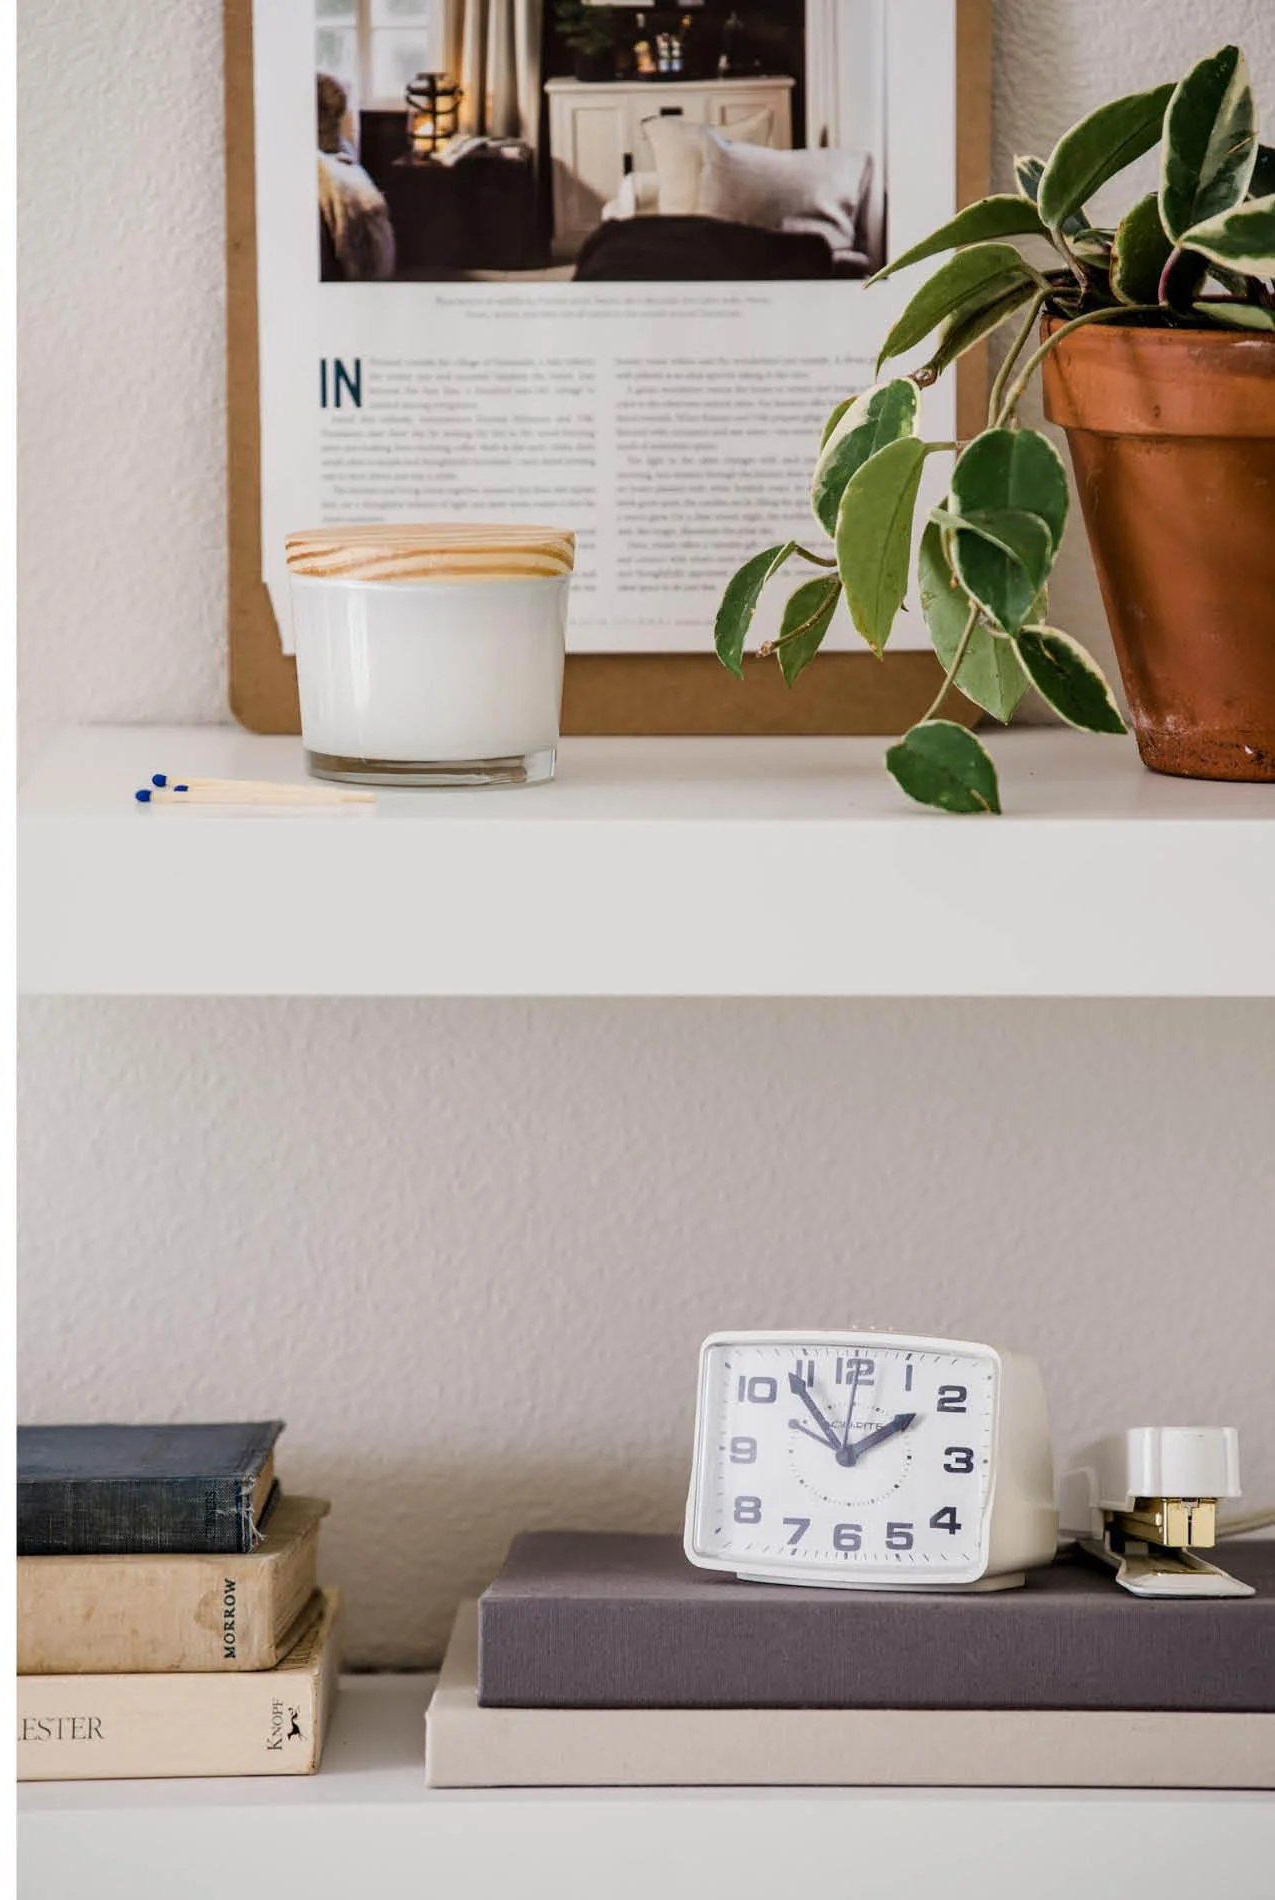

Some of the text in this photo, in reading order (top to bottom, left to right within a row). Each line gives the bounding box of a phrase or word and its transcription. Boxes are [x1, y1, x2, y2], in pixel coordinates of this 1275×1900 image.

[320, 357, 362, 408] IN
[796, 1359, 815, 1388] 11
[835, 1357, 875, 1386] 12
[905, 1364, 913, 1391] 1
[738, 1375, 777, 1404] 10
[936, 1384, 967, 1413] 2
[729, 1436, 757, 1464] 9
[943, 1446, 974, 1474] 3
[733, 1496, 762, 1524] 8
[929, 1506, 962, 1535] 4
[782, 1517, 811, 1545] 7
[833, 1523, 863, 1551] 6
[885, 1522, 914, 1550] 5
[223, 1578, 237, 1659] MORROW
[16, 1716, 105, 1741] ESTER
